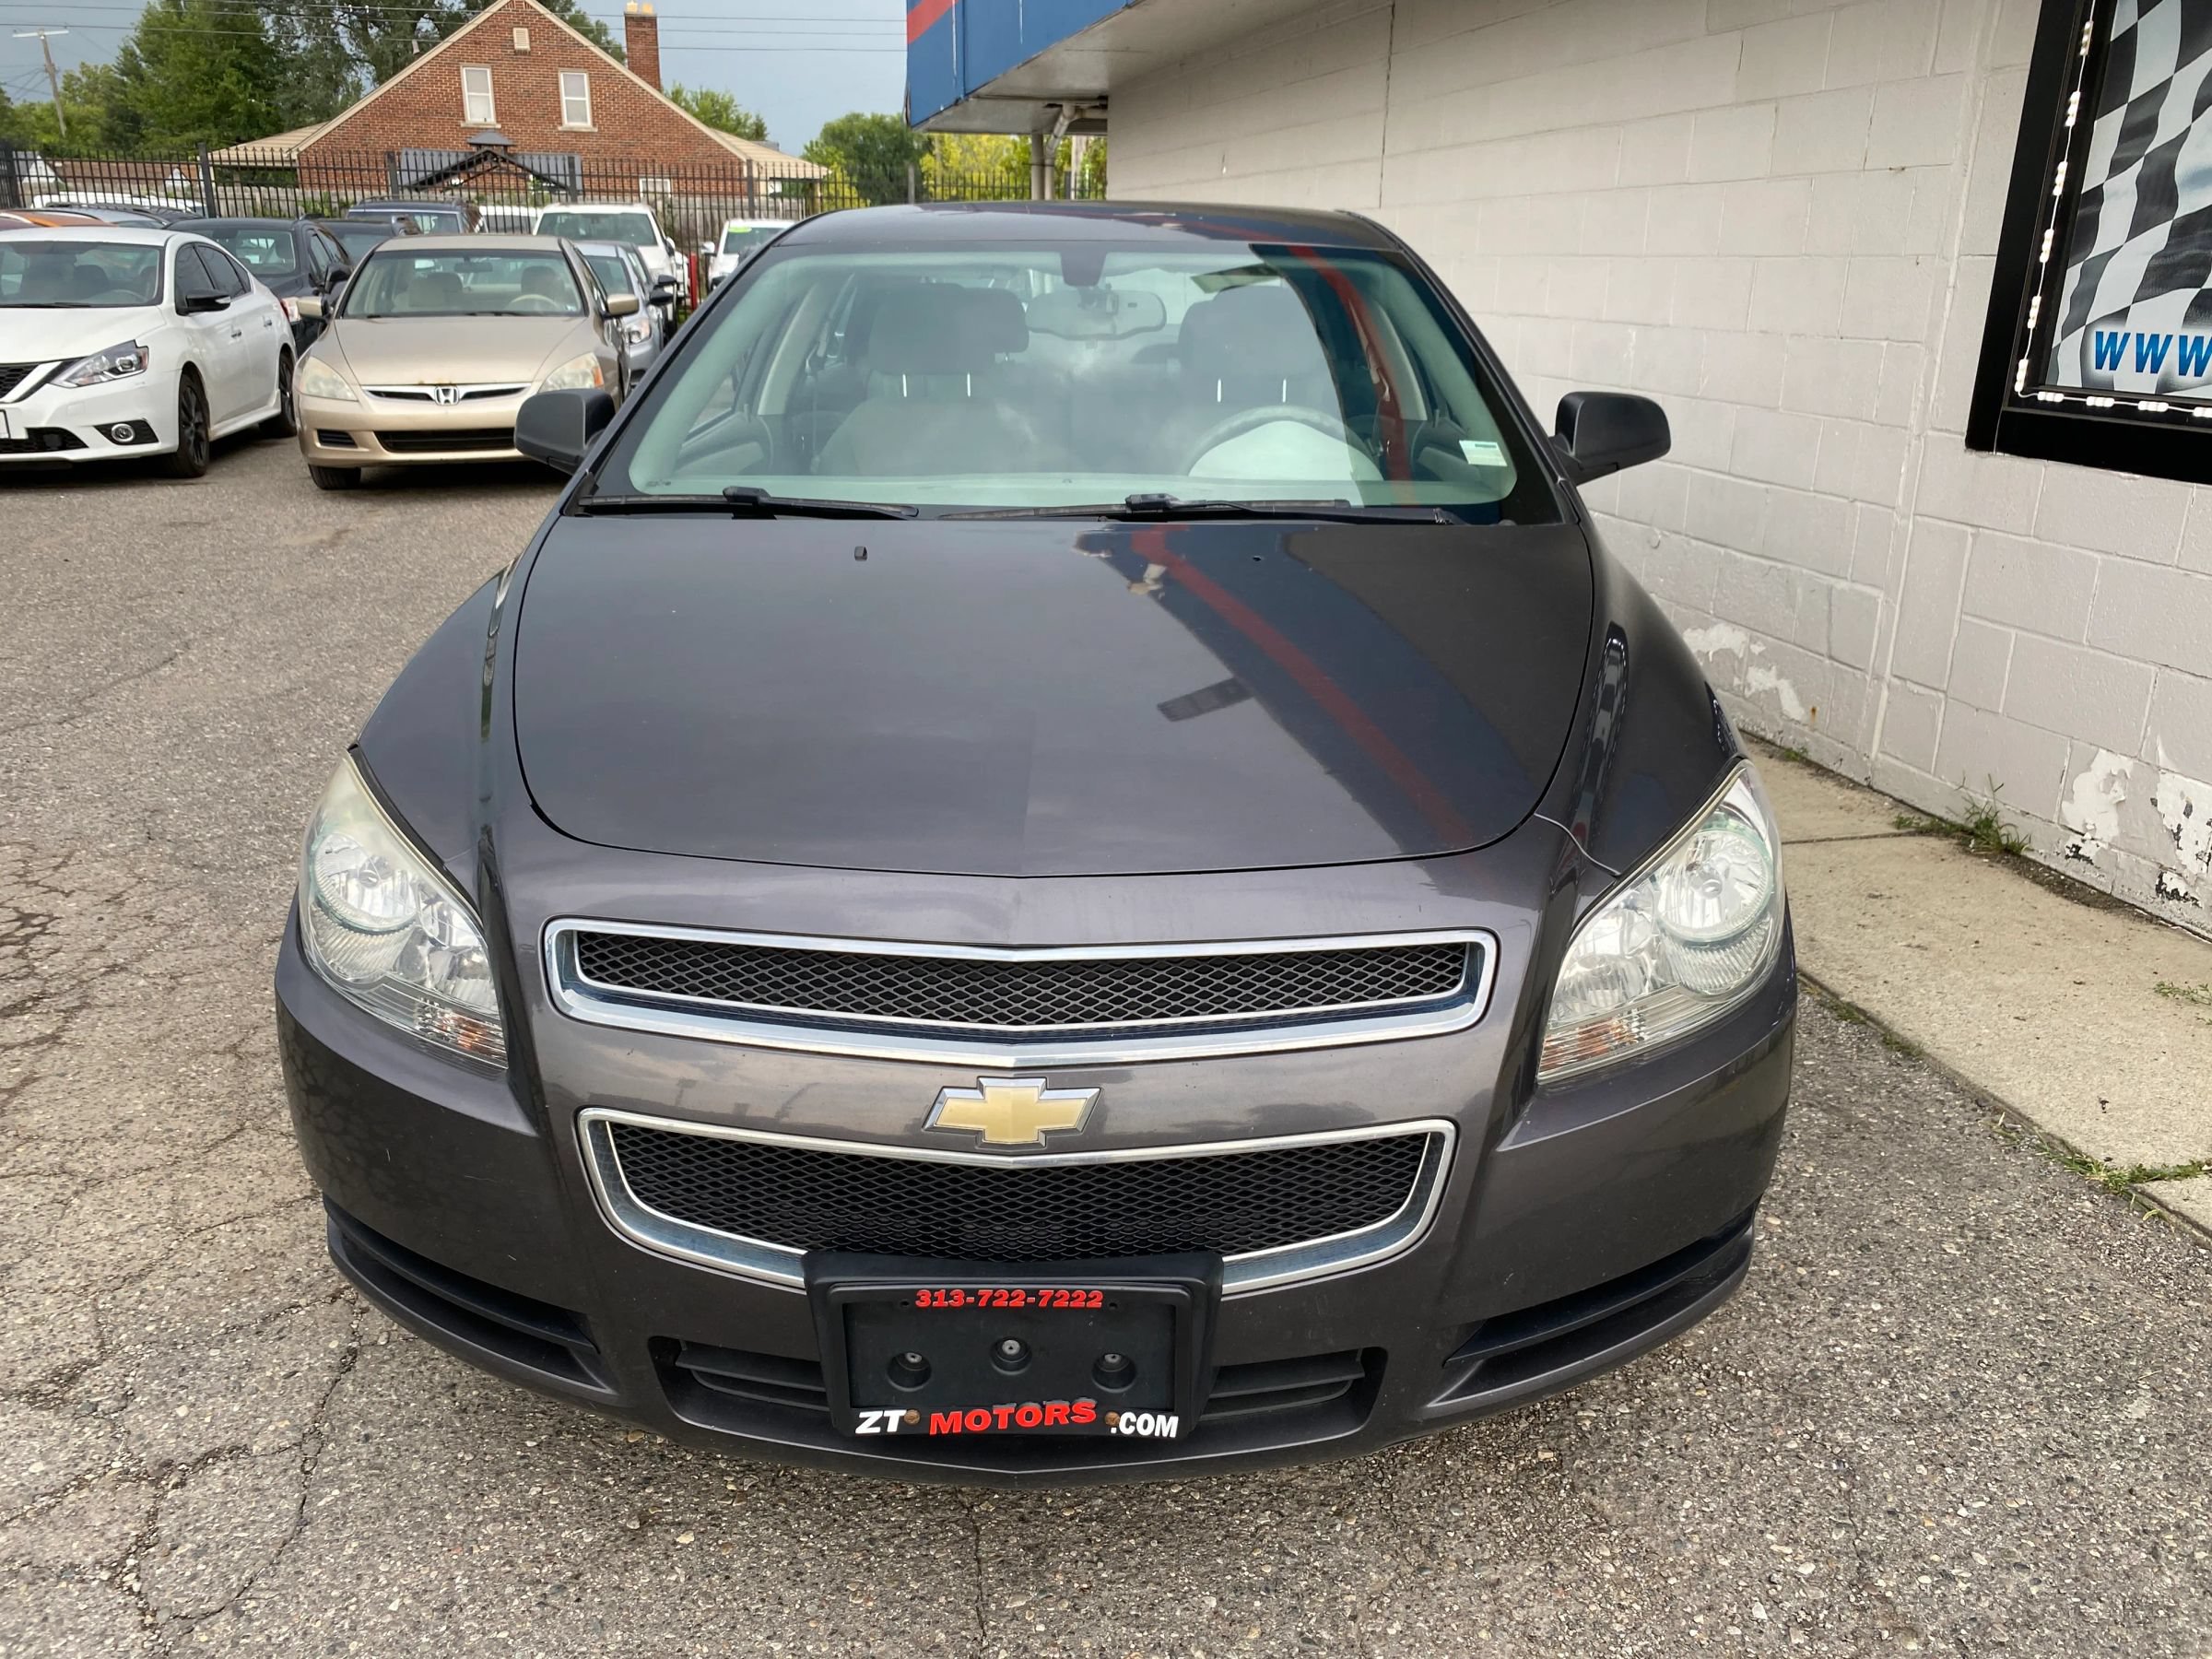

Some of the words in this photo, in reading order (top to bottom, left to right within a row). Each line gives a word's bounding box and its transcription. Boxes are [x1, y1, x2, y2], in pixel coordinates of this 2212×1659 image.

[915, 1289, 1104, 1308] 313-722-7222
[855, 1409, 907, 1434] ZT
[929, 1400, 1097, 1435] MOTORS
[1111, 1412, 1179, 1438] .COM
